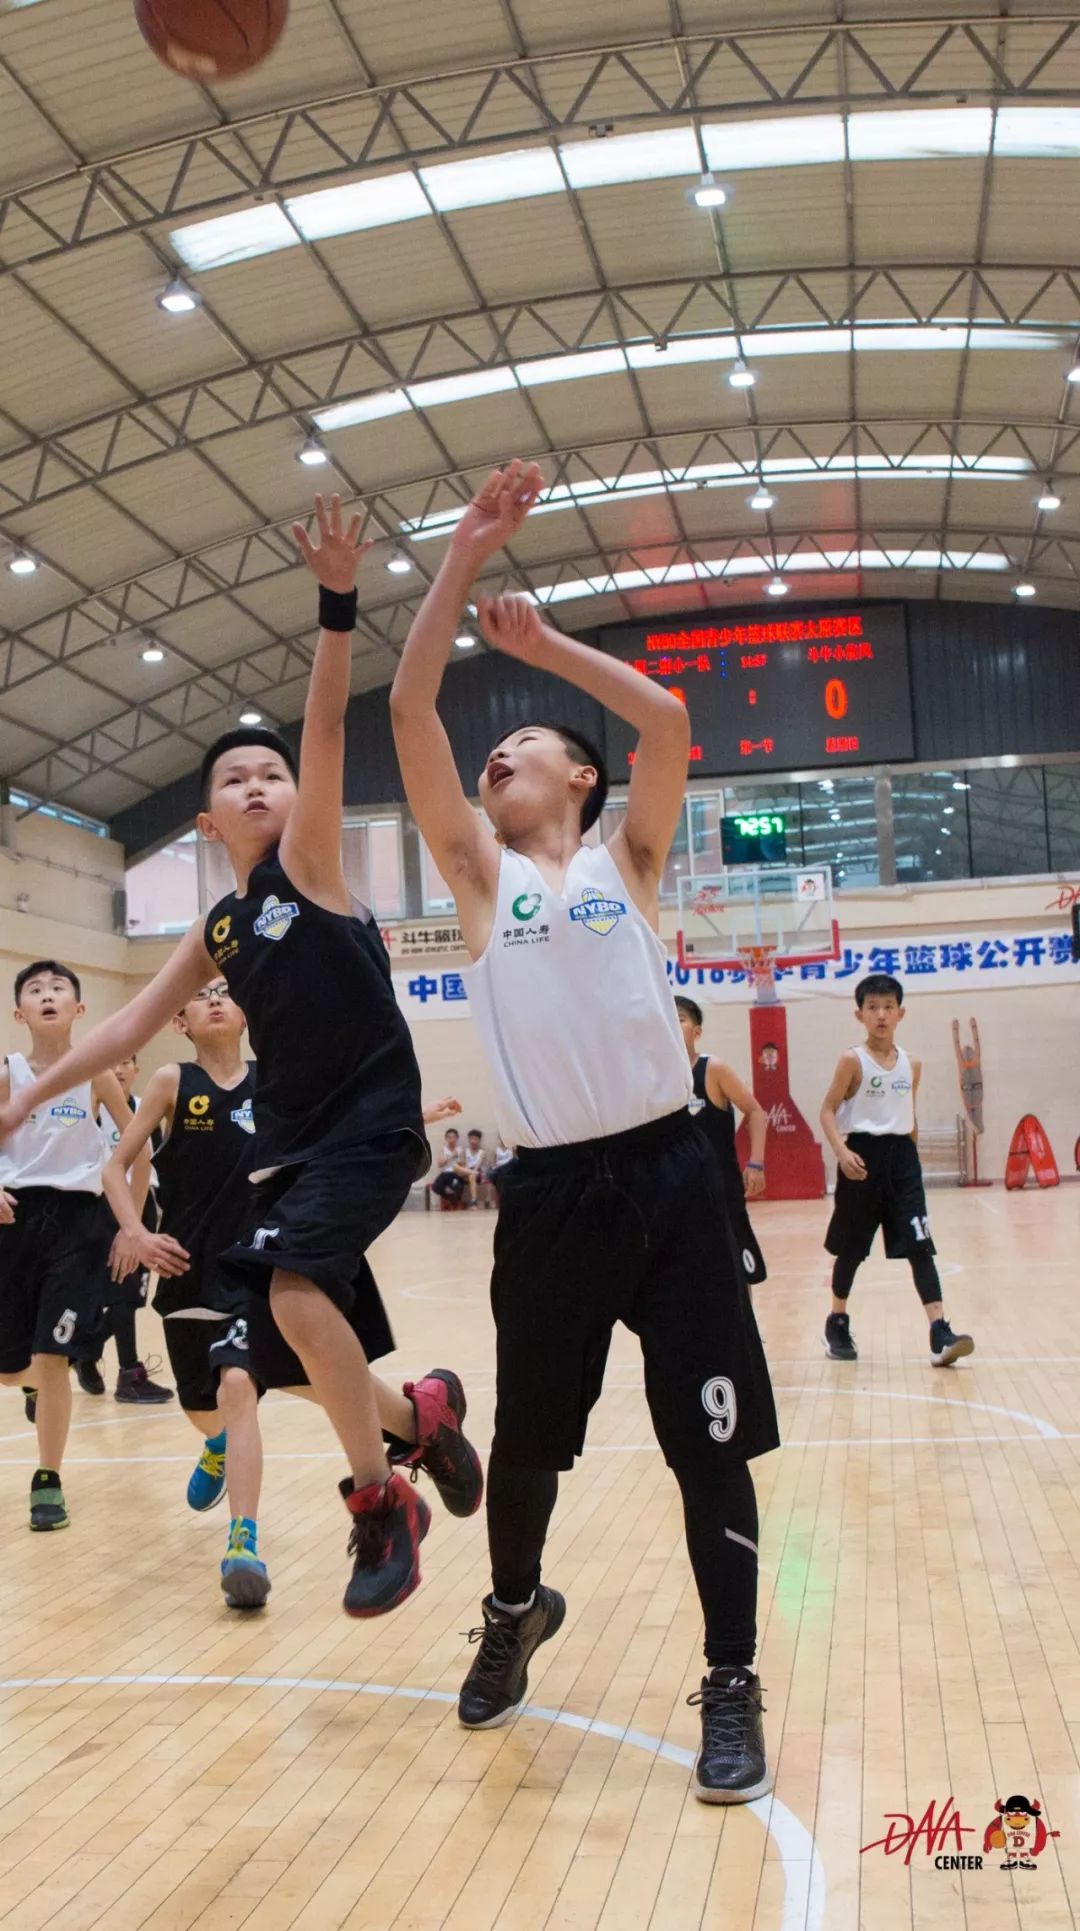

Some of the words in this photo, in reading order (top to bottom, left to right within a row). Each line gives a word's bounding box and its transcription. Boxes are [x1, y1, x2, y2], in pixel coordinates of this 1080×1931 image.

[825, 679, 848, 720] 0
[503, 924, 550, 940] 中国人寿
[503, 938, 529, 948] CHINA
[531, 936, 551, 944] LIFE
[408, 973, 468, 1003] 中国
[53, 1308, 78, 1344] 5
[701, 1376, 737, 1442] 9
